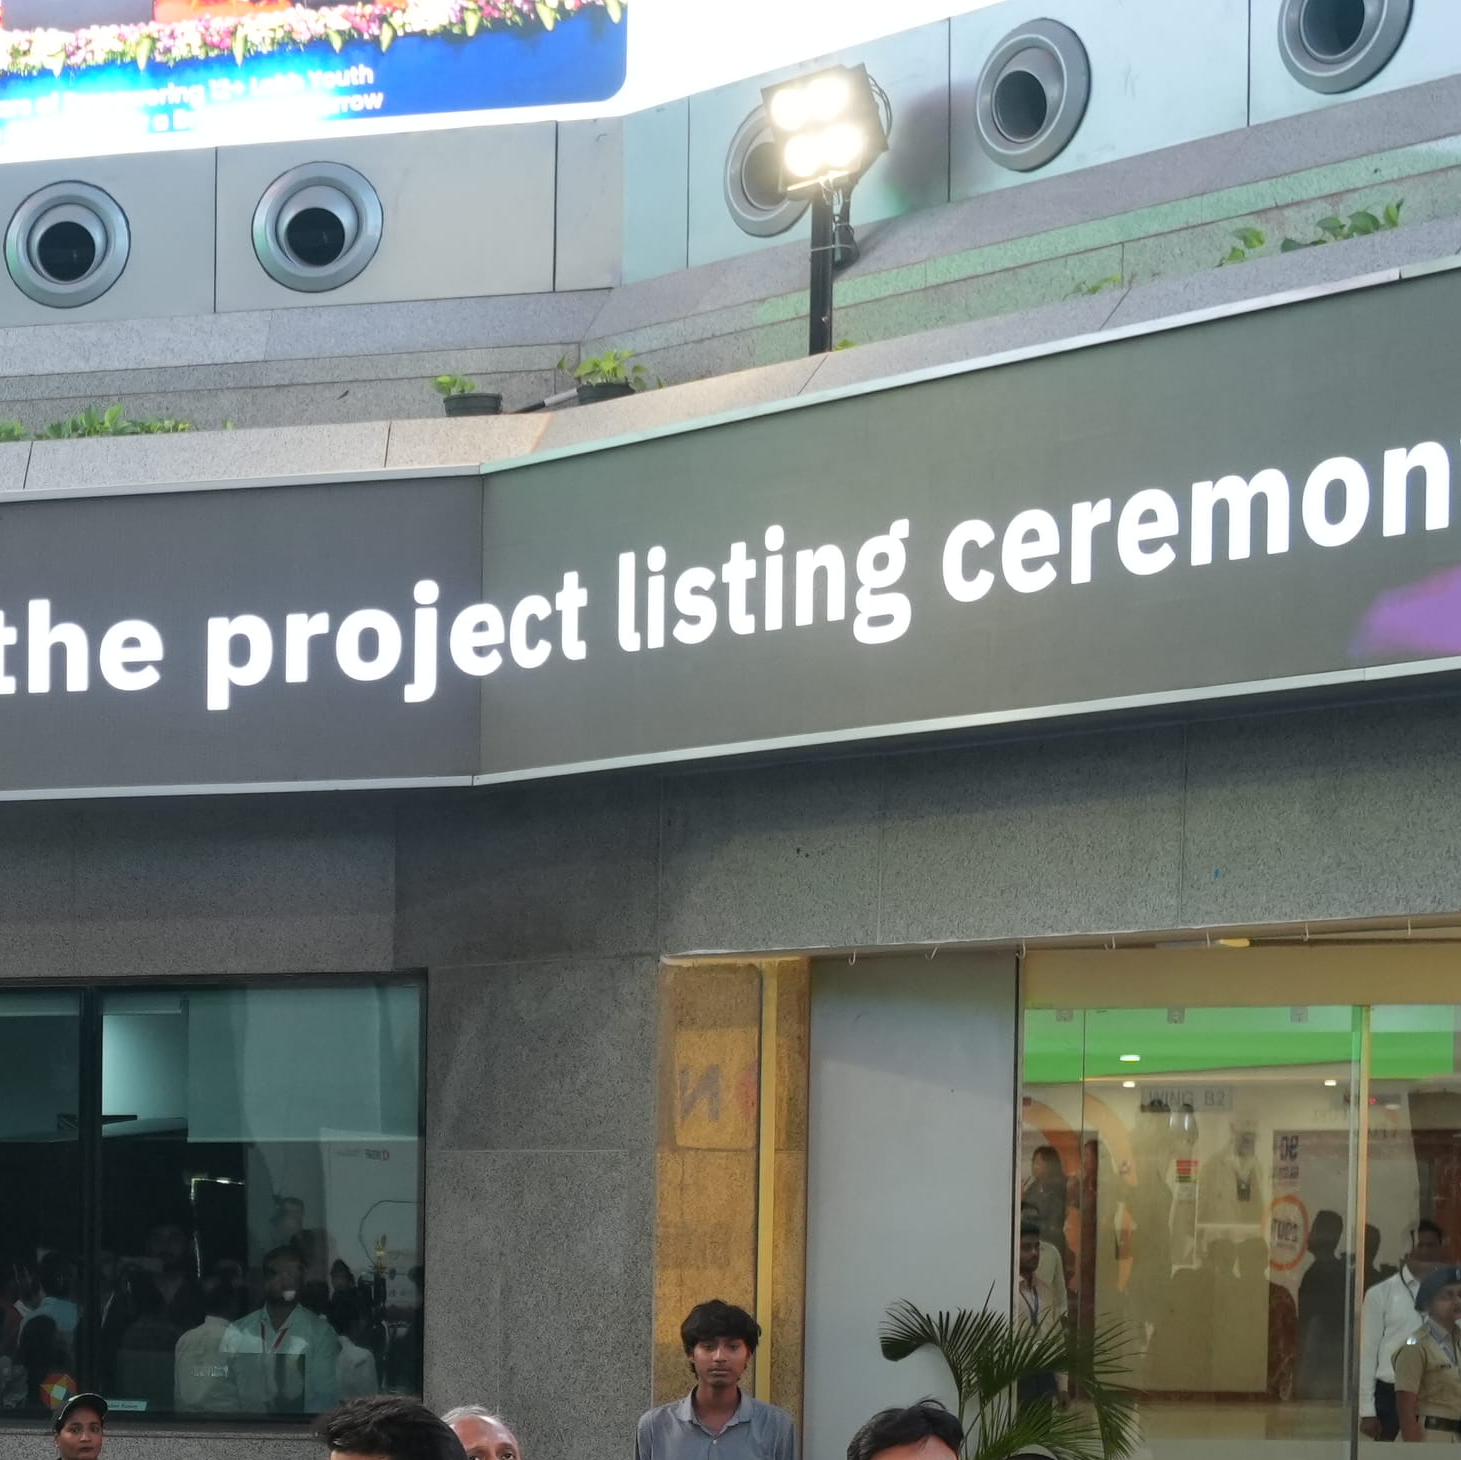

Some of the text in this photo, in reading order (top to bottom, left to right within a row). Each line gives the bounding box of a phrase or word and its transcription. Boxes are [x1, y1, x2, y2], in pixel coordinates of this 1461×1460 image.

[308, 64, 374, 89] Youth
[207, 578, 588, 712] project
[615, 518, 910, 652] listing
[941, 437, 1461, 603] ceremon
